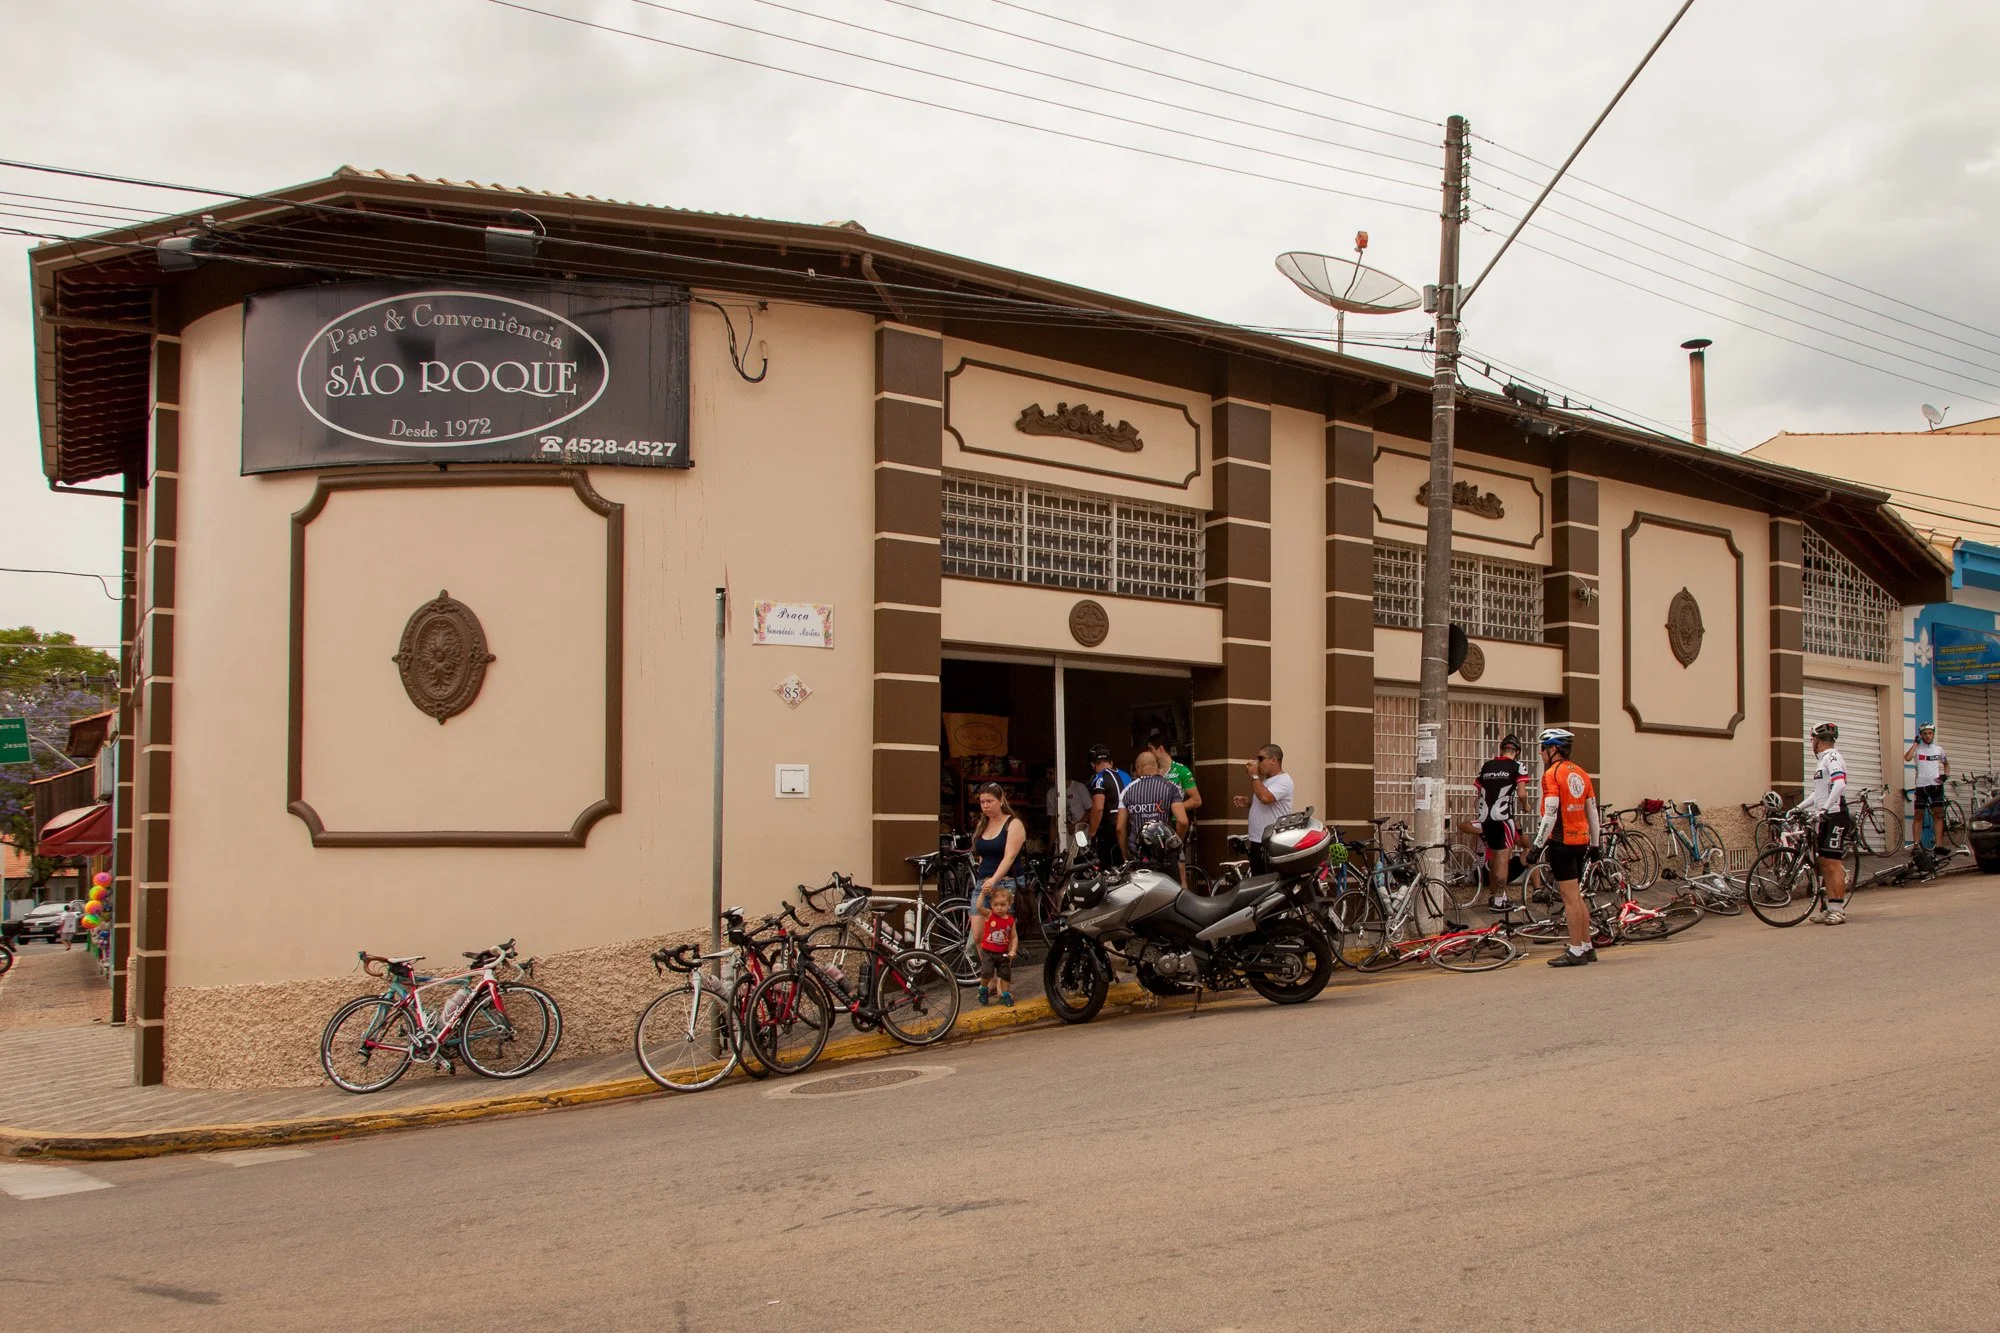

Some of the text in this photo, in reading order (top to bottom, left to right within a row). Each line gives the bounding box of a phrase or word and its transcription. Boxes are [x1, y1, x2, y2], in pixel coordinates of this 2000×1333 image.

[326, 303, 564, 354] Pães & Conveniência
[324, 357, 578, 398] SÃO ROQUE
[389, 418, 492, 438] Desde 1972
[564, 437, 678, 458] 4528-4527
[778, 607, 809, 622] Praça
[784, 686, 799, 699] 85
[1829, 825, 1845, 848] CLR
